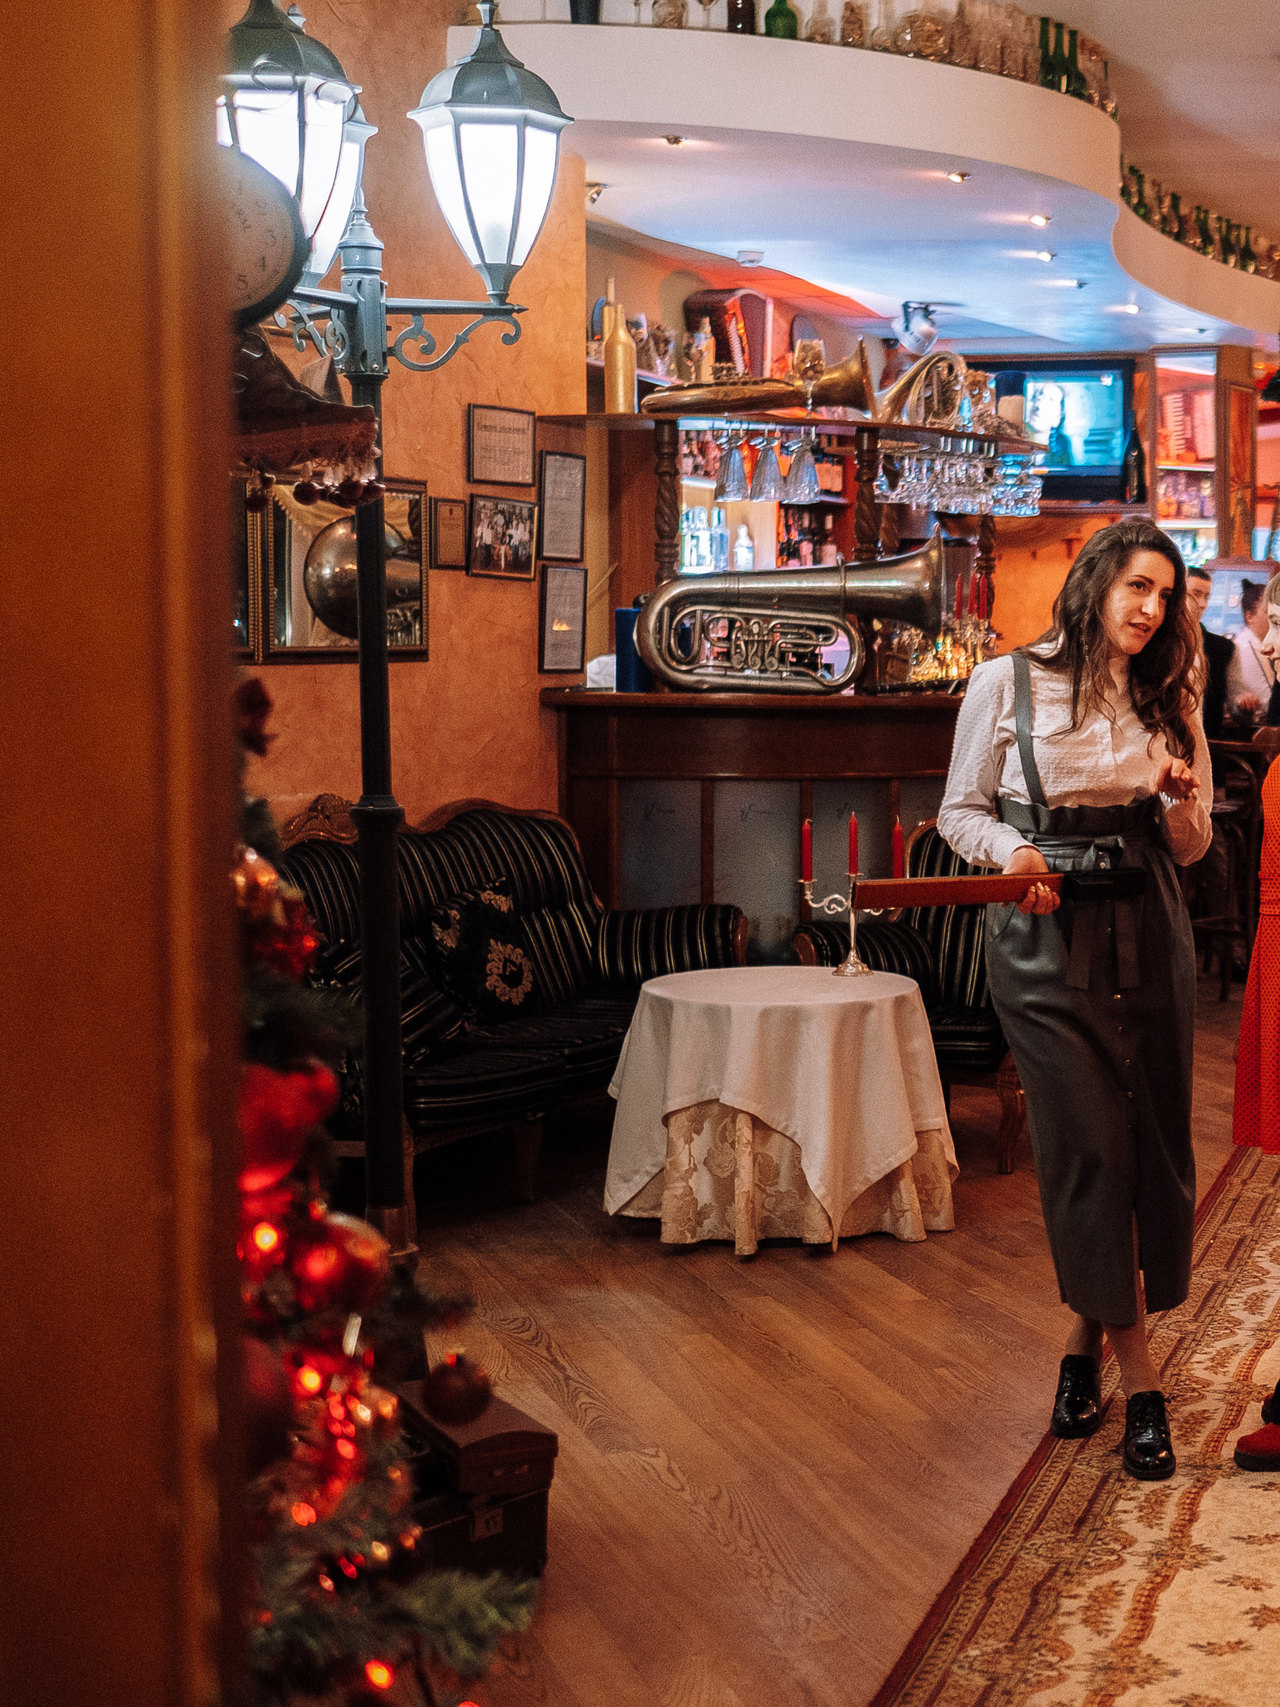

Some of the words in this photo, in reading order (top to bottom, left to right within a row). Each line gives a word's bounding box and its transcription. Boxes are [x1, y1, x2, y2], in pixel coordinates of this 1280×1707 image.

[264, 228, 278, 248] 3
[254, 255, 268, 272] 4
[235, 274, 249, 291] 5
